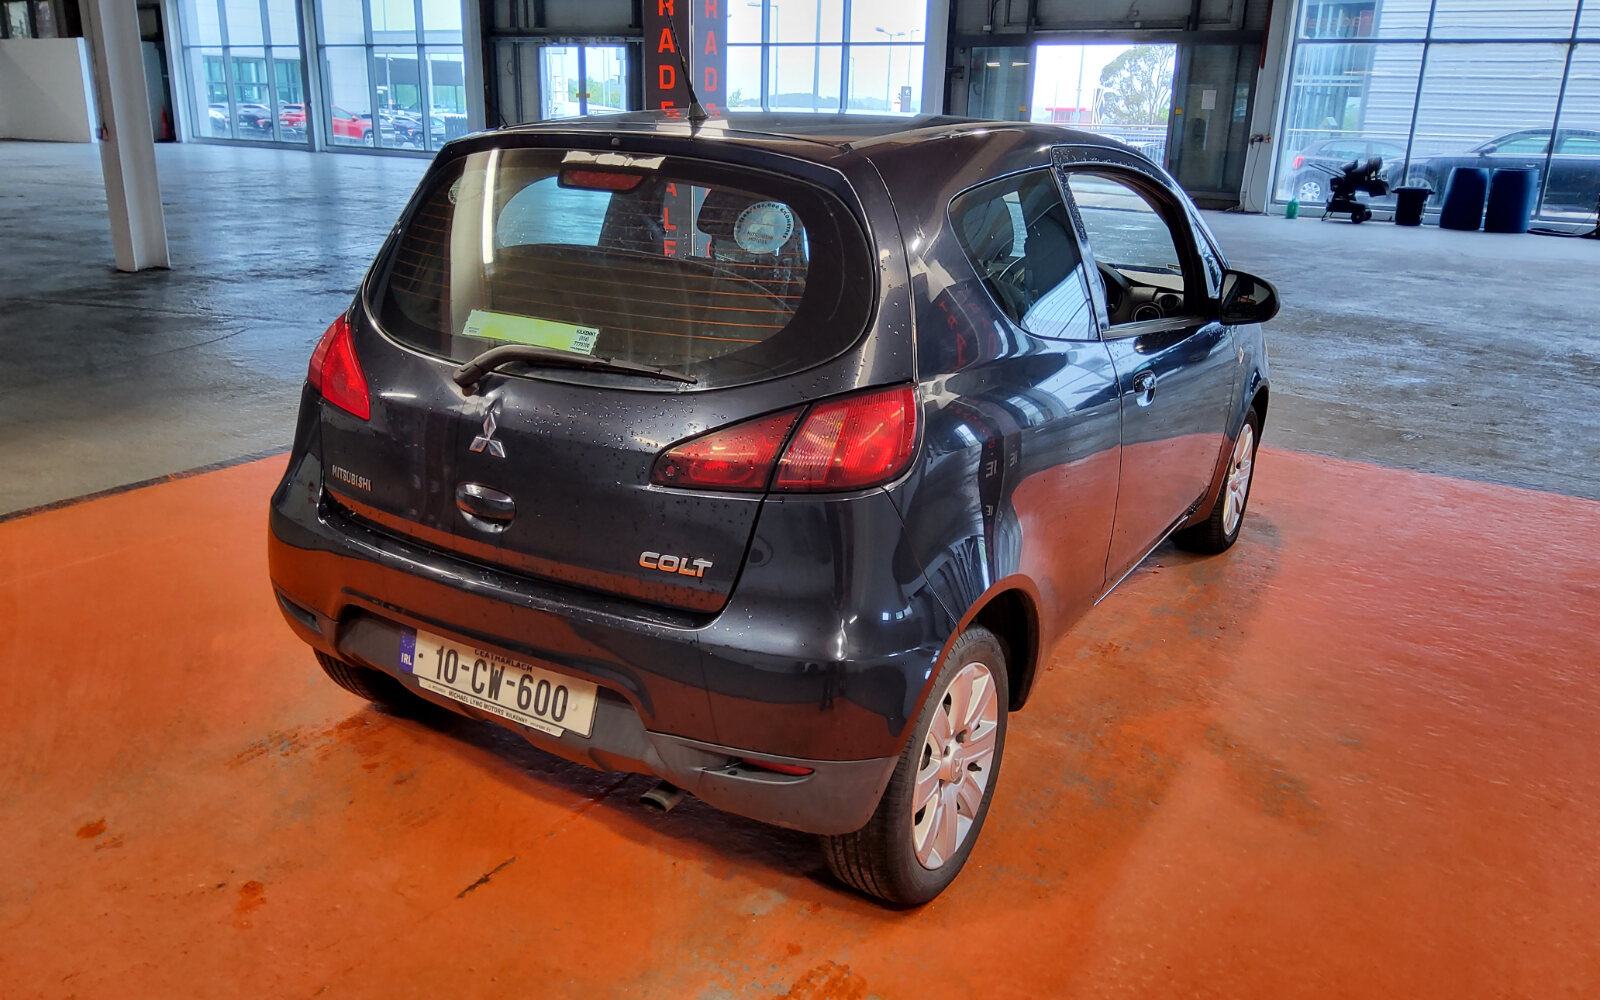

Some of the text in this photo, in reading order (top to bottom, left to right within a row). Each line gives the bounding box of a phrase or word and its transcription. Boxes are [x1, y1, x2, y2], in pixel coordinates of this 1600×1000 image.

[332, 464, 372, 491] MITSUBISHI
[639, 551, 713, 578] COLT
[401, 652, 413, 666] IRL
[436, 645, 569, 722] 10-CW-600
